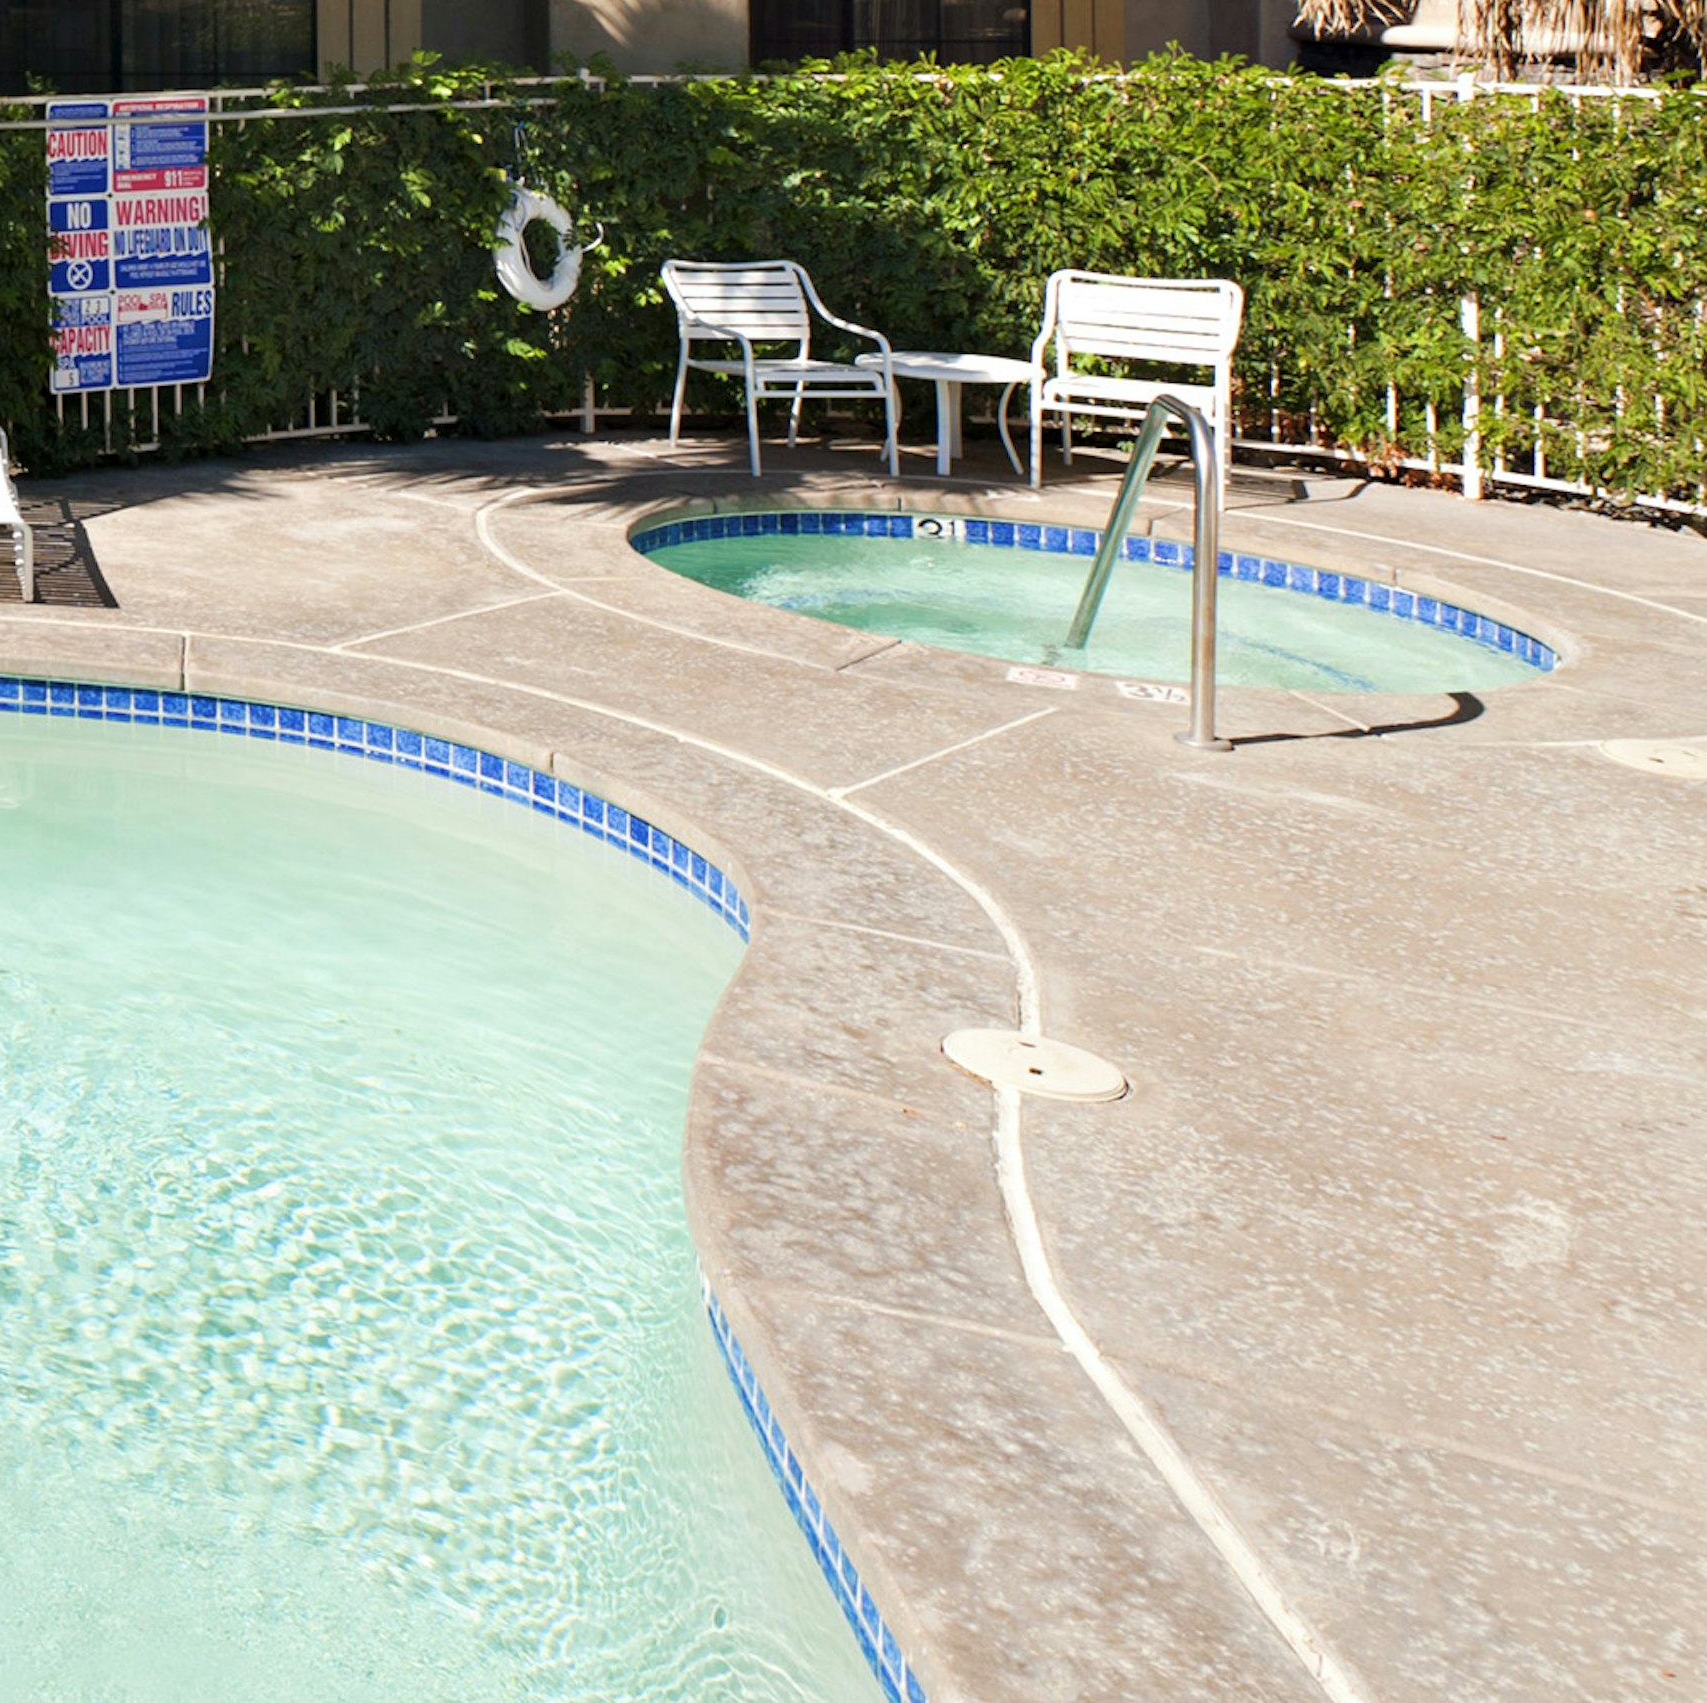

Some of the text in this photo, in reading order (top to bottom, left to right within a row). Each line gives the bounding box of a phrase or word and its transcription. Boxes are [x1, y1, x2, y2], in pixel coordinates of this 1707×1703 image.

[47, 131, 107, 157] CAUTION
[164, 169, 183, 187] 911
[66, 202, 92, 229] NO
[115, 196, 206, 226] WARNING!
[128, 227, 171, 255] LIFEGUARD
[172, 290, 212, 316] RULES
